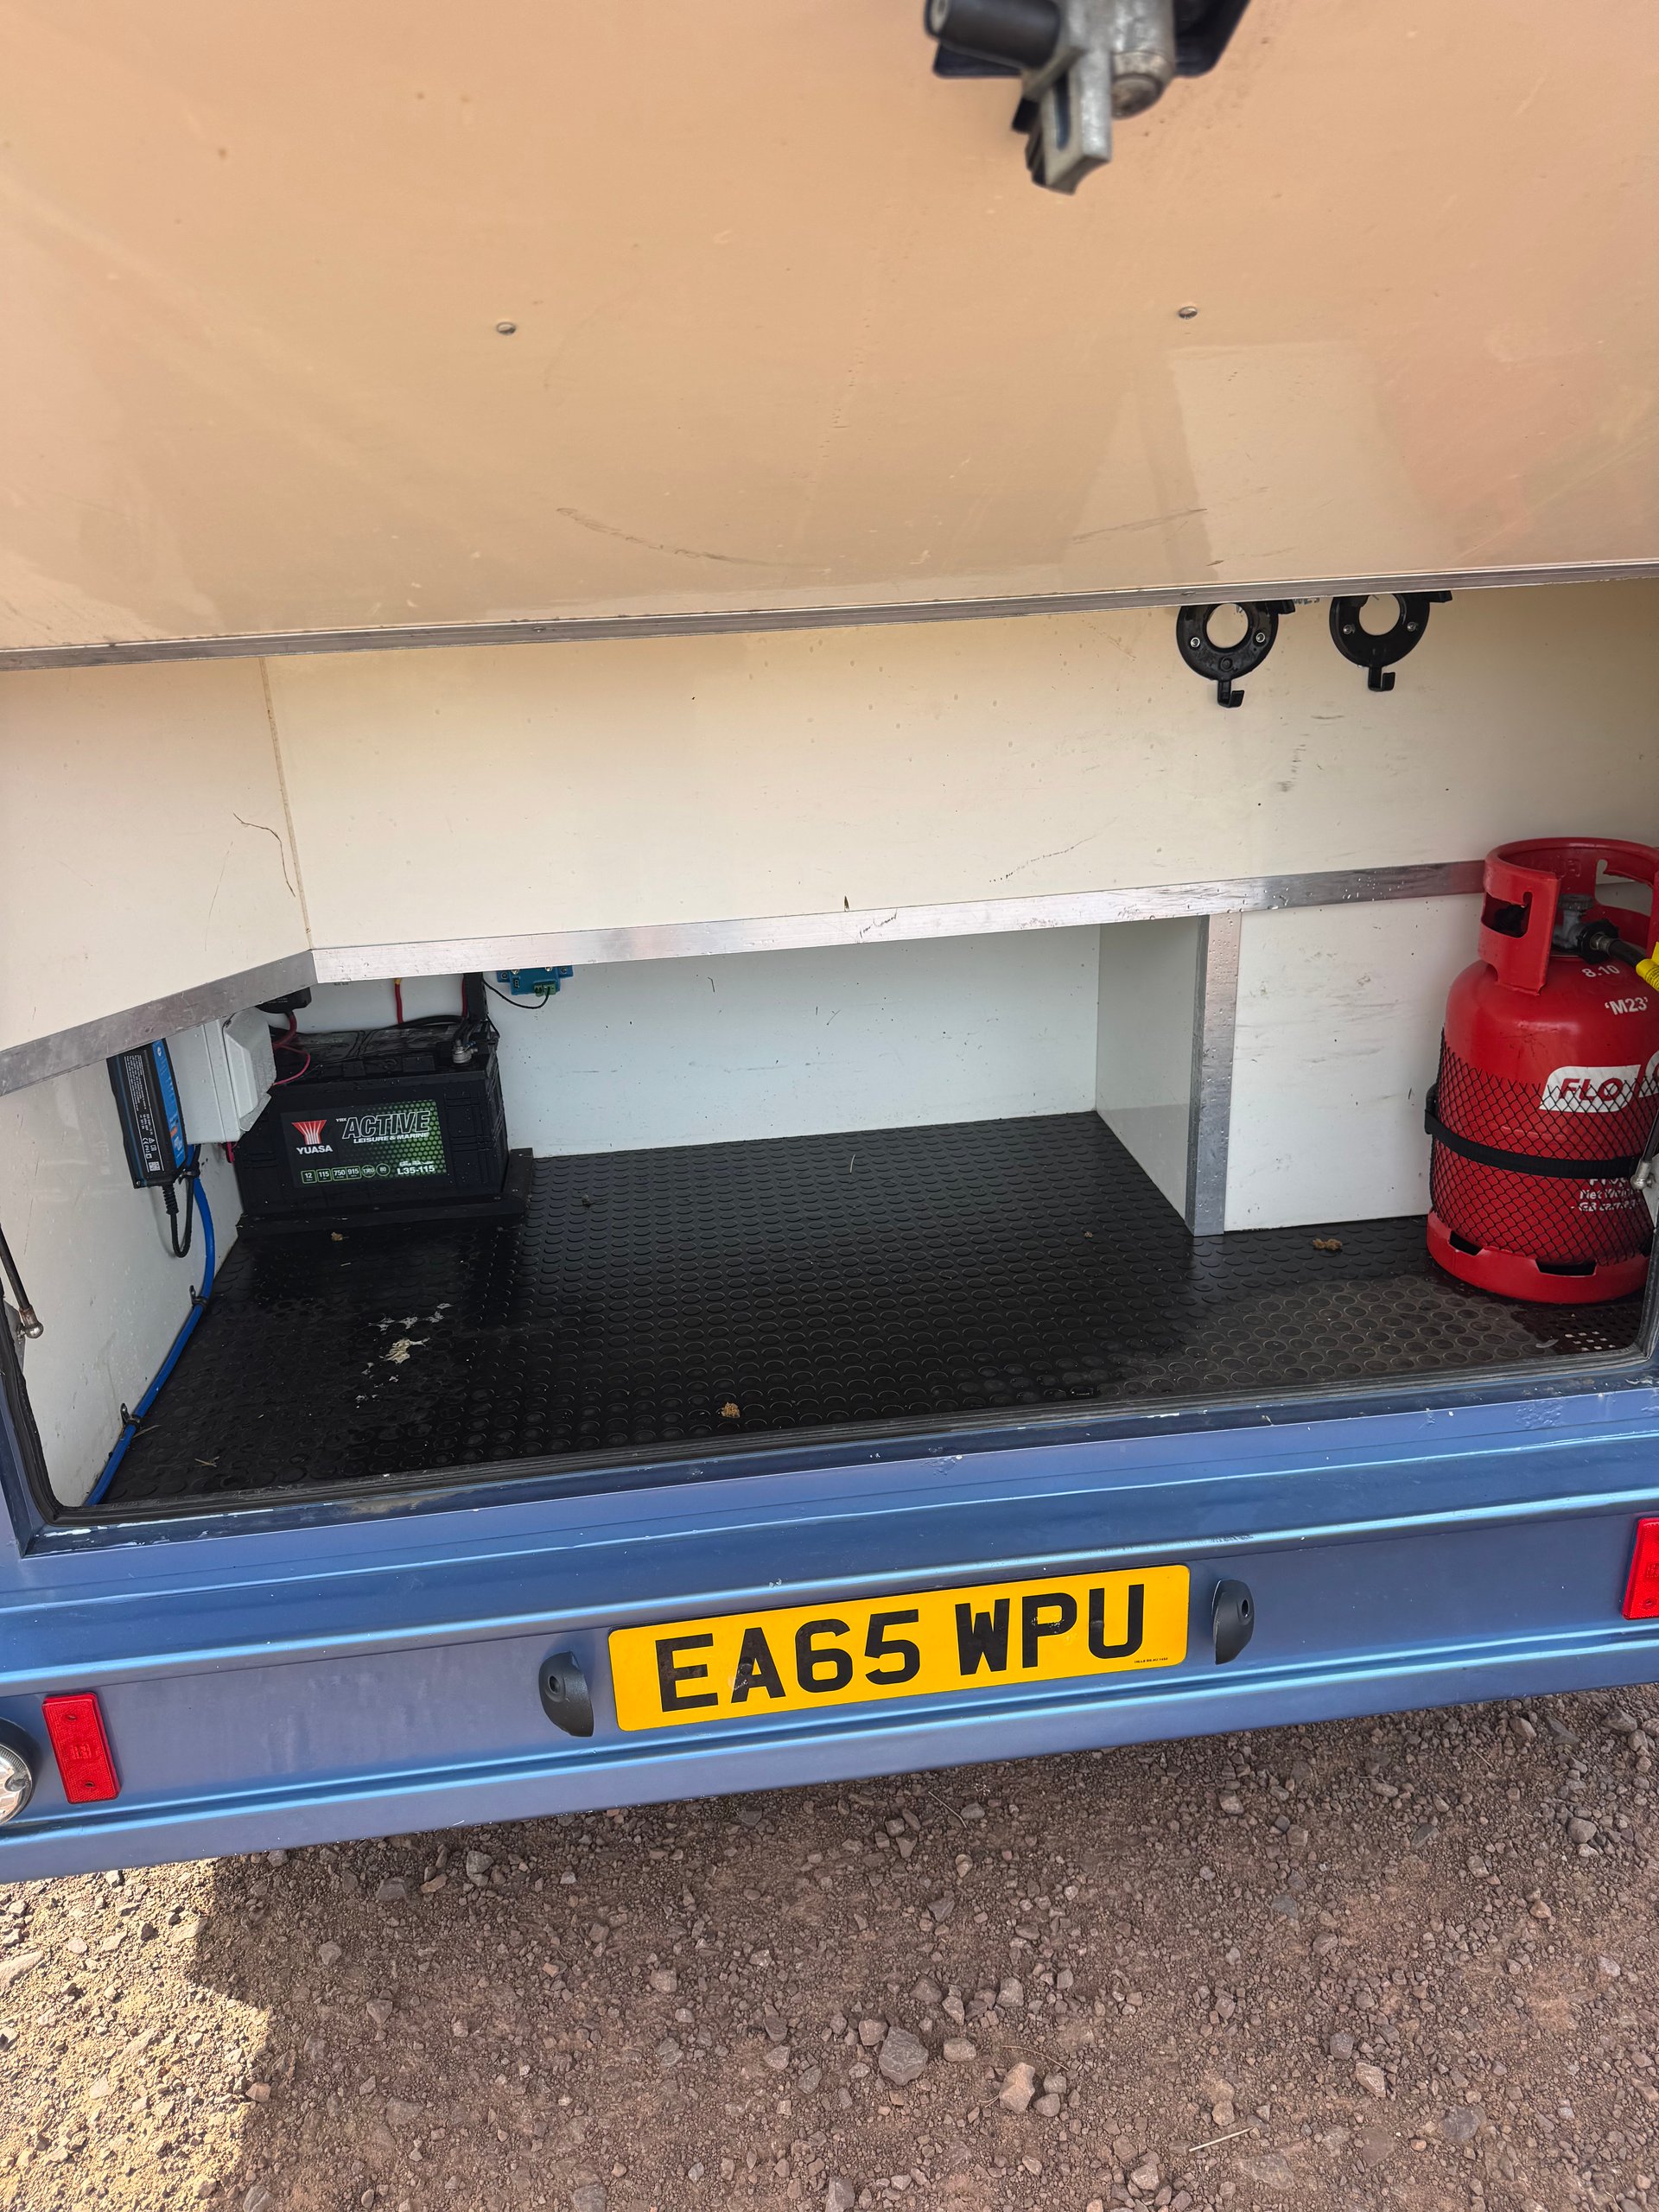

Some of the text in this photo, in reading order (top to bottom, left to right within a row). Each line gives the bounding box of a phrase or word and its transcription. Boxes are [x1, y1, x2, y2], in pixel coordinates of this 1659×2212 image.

[1581, 965, 1620, 978] 8.10
[341, 1110, 430, 1140] ACTIVE
[353, 1135, 389, 1144] LEISURE
[296, 1145, 334, 1155] YUASA
[397, 1164, 435, 1175] L35-115
[654, 1583, 1145, 1713] EA65 WPU
